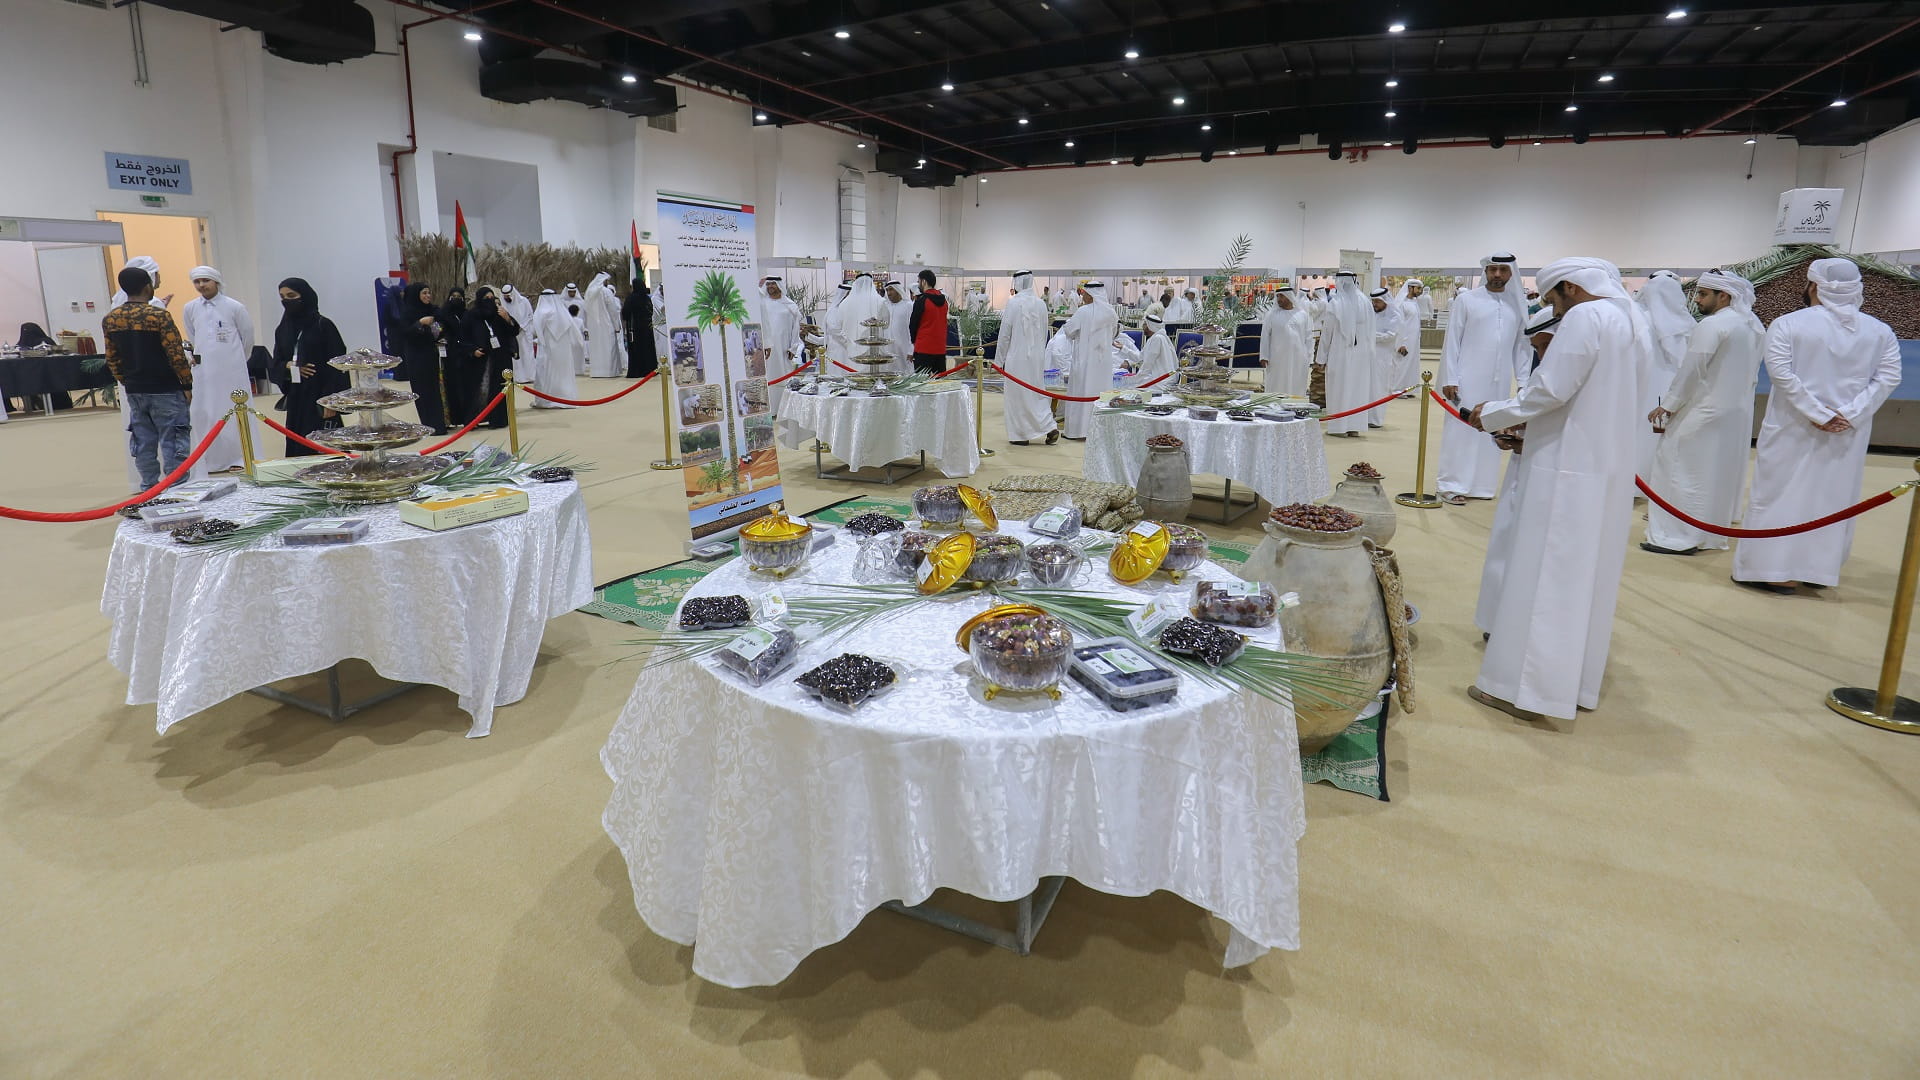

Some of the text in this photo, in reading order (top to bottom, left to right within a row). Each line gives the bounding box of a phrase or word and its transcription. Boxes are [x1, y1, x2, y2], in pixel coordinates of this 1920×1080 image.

[115, 158, 181, 176] الخروج فقط
[120, 175, 180, 188] EXIT ONLY
